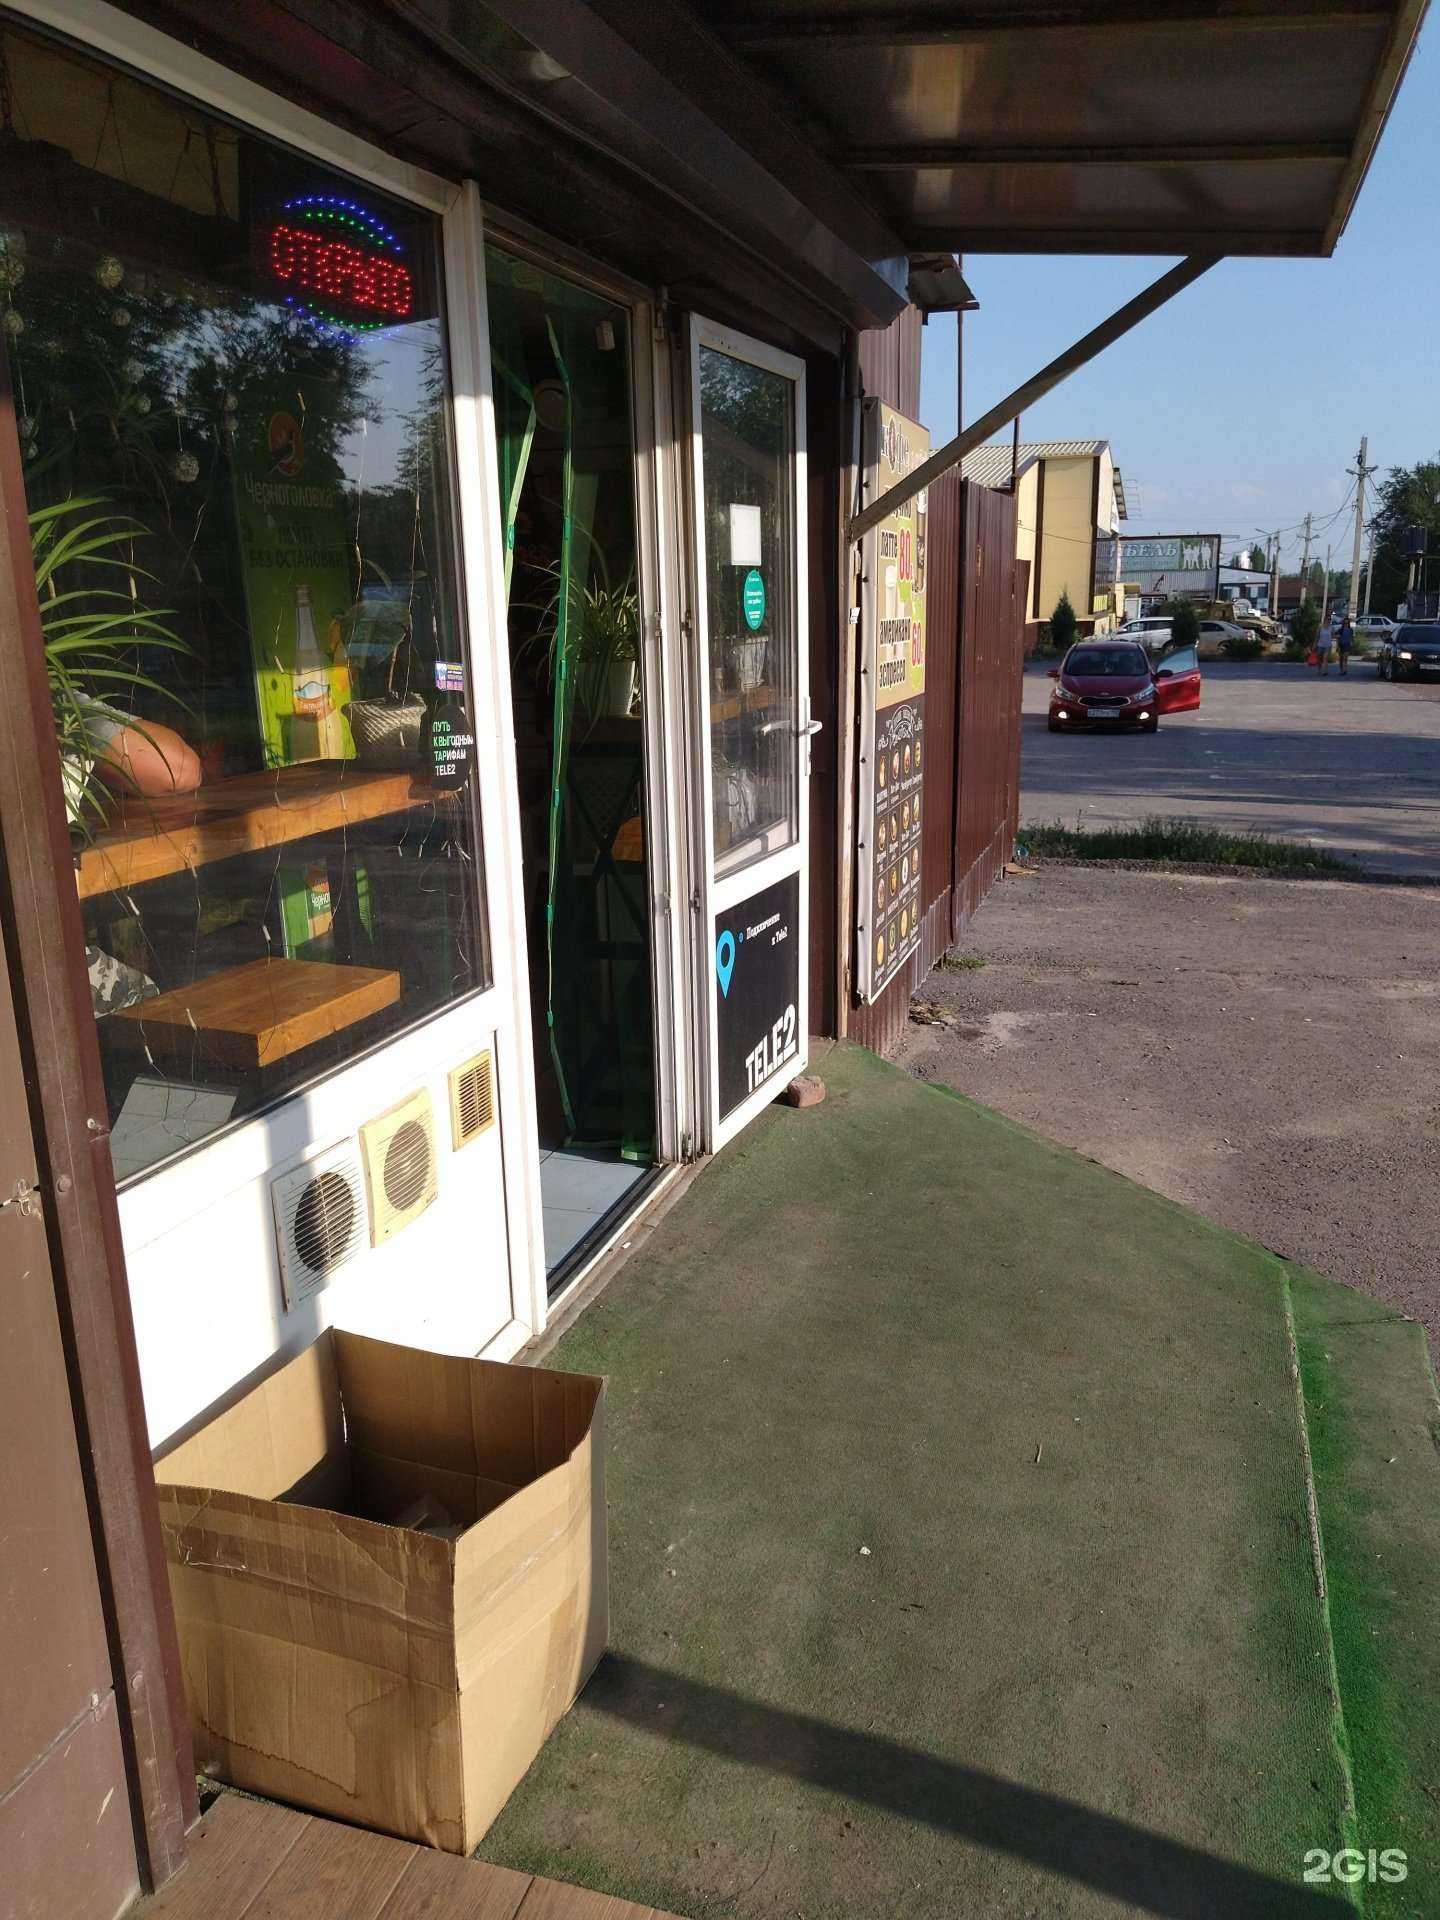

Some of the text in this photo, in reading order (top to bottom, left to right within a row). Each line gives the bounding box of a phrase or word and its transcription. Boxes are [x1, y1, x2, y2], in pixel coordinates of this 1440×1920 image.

[243, 473, 335, 513] Черноголовка
[881, 531, 898, 558] латте
[276, 548, 343, 569] ОСТАНОВКИ
[880, 618, 911, 647] американо
[432, 721, 451, 733] ПУТЬ
[433, 735, 474, 748] К ВЫГОДНЫМ
[434, 748, 467, 761] ТАРИФАМ
[435, 763, 456, 776] TELE2
[775, 926, 788, 943] Tele2
[745, 1003, 796, 1094] TELE2
